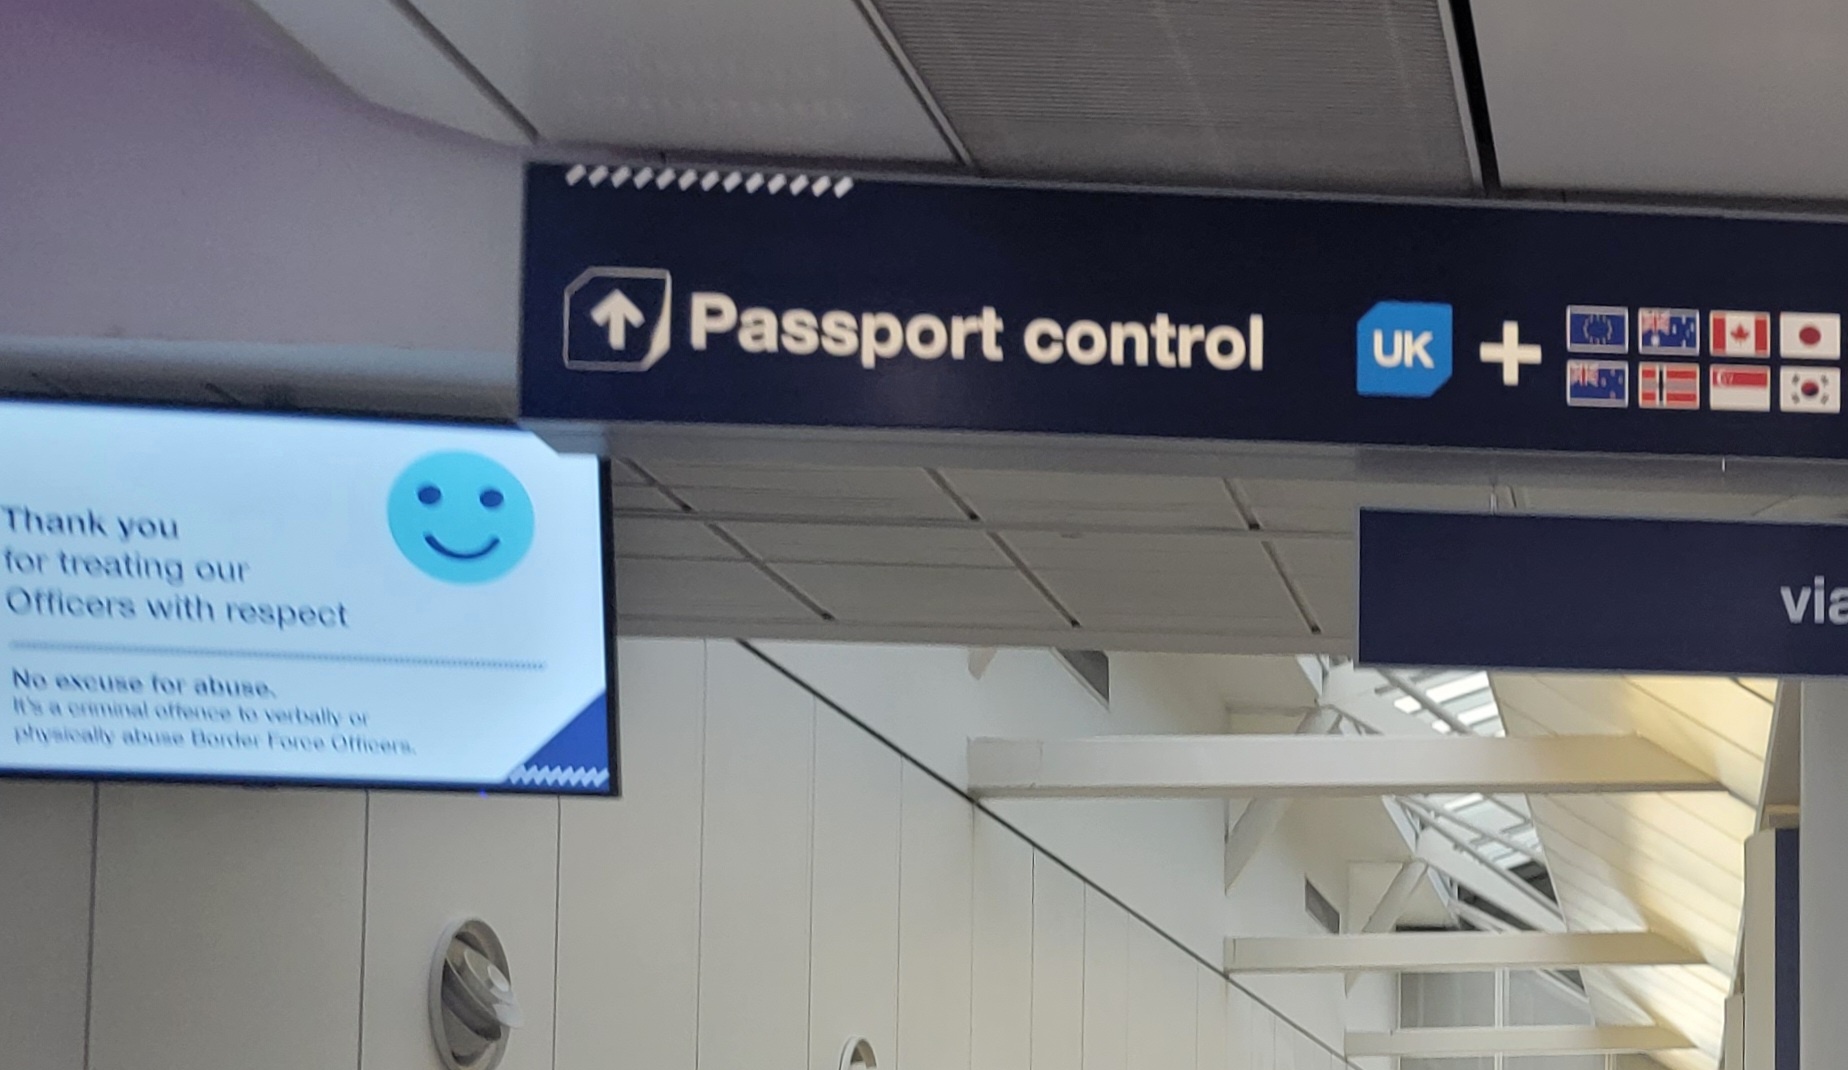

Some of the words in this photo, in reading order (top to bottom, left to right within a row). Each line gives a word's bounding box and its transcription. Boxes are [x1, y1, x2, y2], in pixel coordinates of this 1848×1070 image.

[690, 291, 1003, 370] Passport
[1023, 313, 1265, 372] control
[1372, 329, 1435, 371] UK
[2, 504, 108, 537] Thank
[117, 514, 180, 543] you
[2, 547, 47, 575] for
[59, 550, 185, 587] treating
[195, 559, 250, 583] our
[6, 586, 137, 619] Officers
[146, 594, 215, 623] with
[225, 601, 350, 630] respect
[12, 667, 47, 690] No
[55, 675, 143, 694] excuse
[151, 672, 187, 695] for
[13, 696, 44, 717] It's
[49, 703, 62, 718] a
[68, 699, 148, 720] criminal
[154, 701, 232, 723] offence
[238, 703, 259, 723] to
[265, 705, 341, 728] verbally
[349, 711, 371, 727] or
[14, 723, 114, 746] physically
[122, 727, 185, 747] abuse
[191, 728, 261, 749] Border
[268, 730, 325, 752] Force
